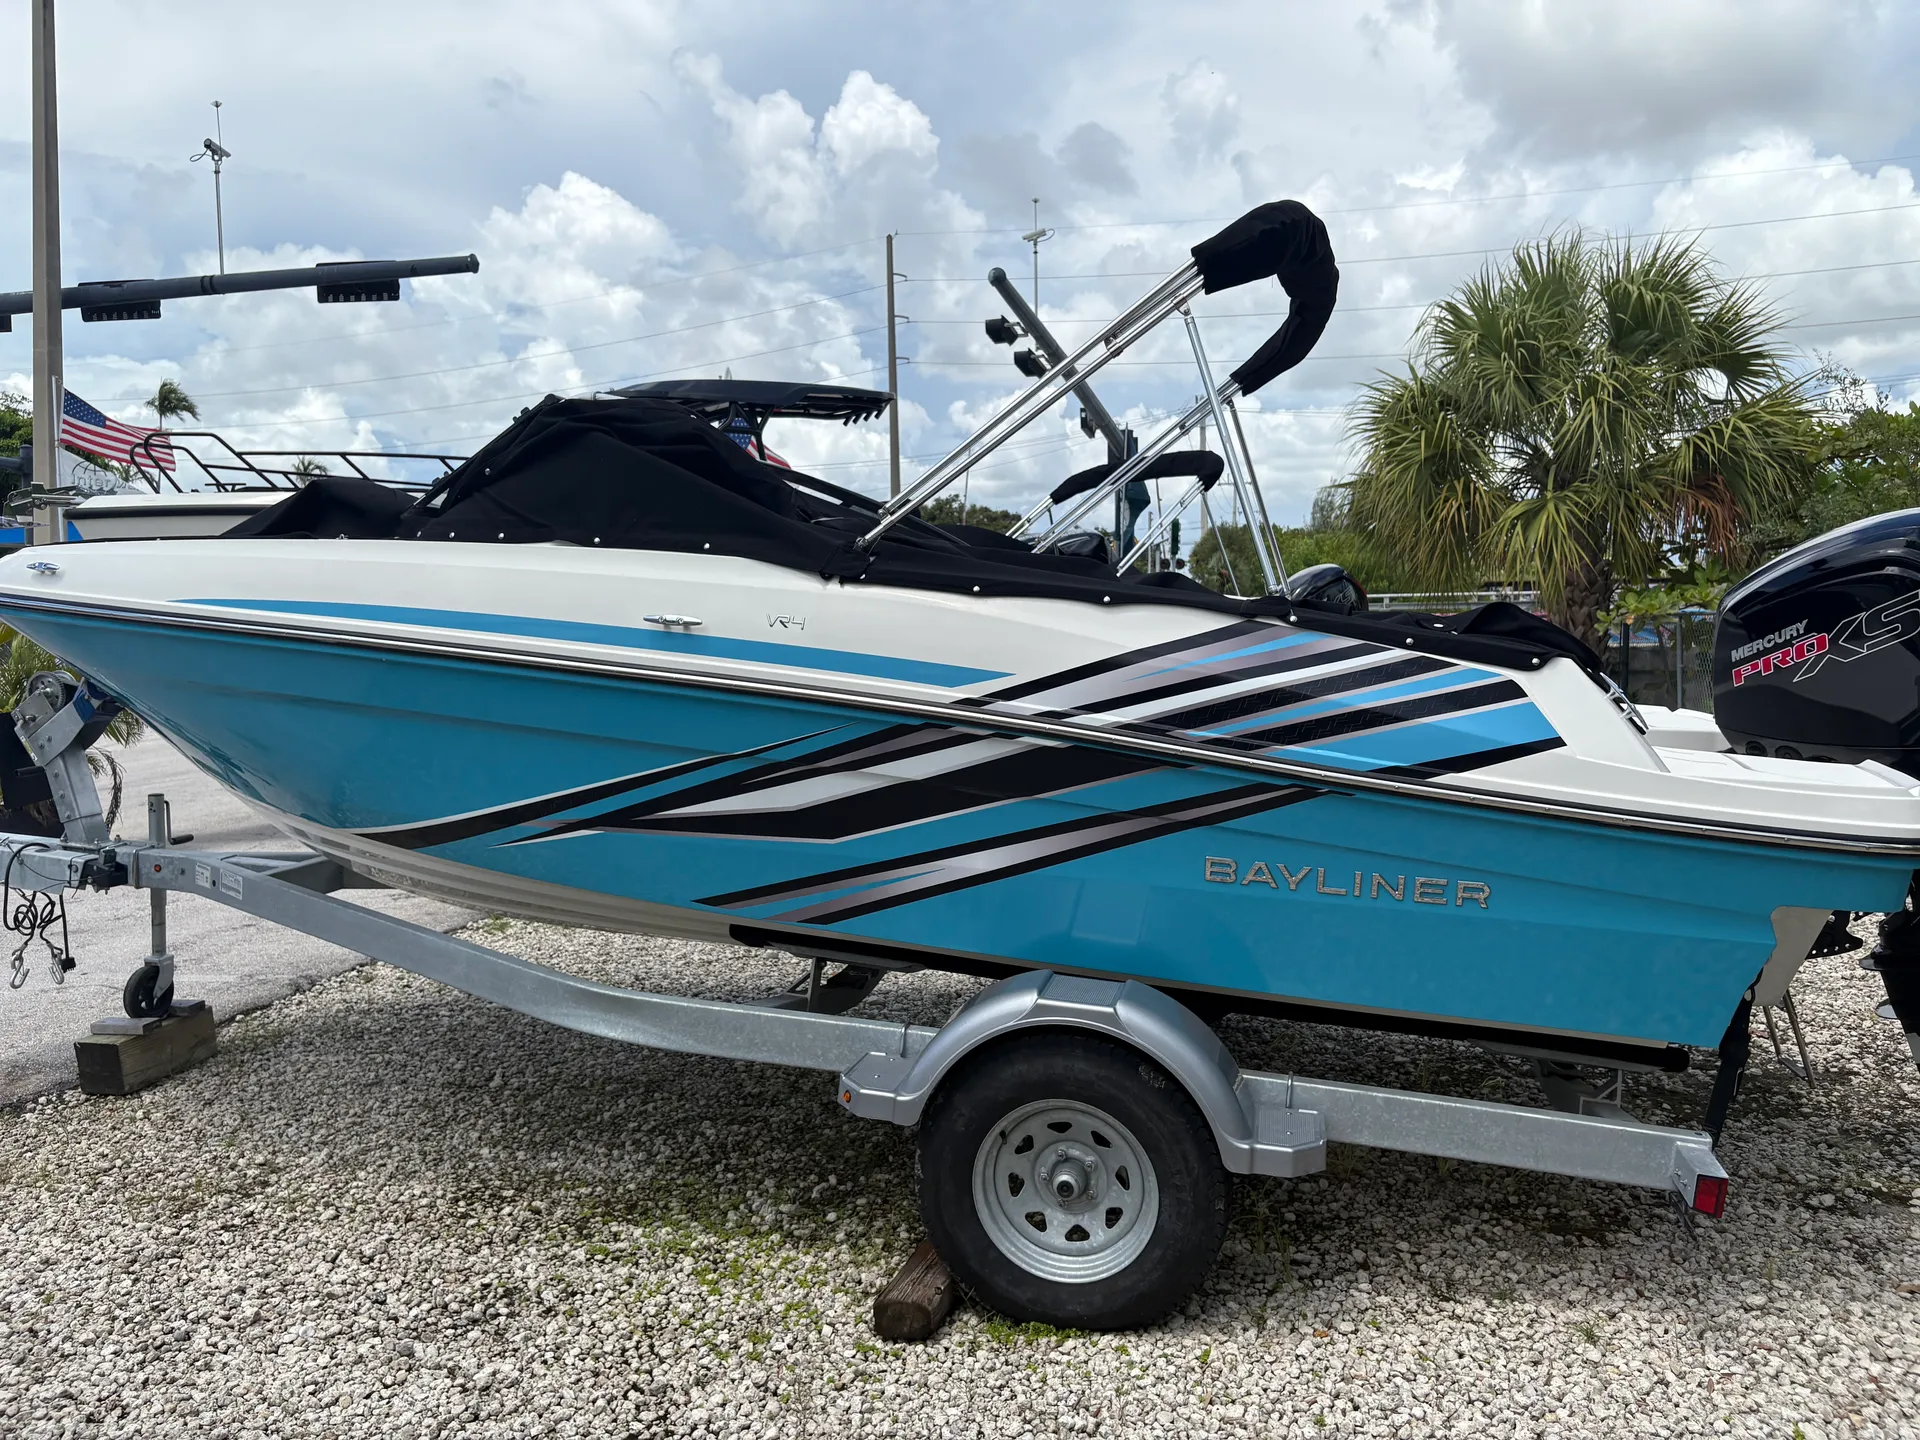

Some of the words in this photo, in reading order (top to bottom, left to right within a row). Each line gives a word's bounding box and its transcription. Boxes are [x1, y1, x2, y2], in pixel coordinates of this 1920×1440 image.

[766, 613, 806, 631] VR4
[1731, 619, 1808, 662] MERCURY
[1732, 633, 1828, 687] PRO
[1792, 589, 1920, 682] XS
[1204, 856, 1491, 909] BAYLINER
